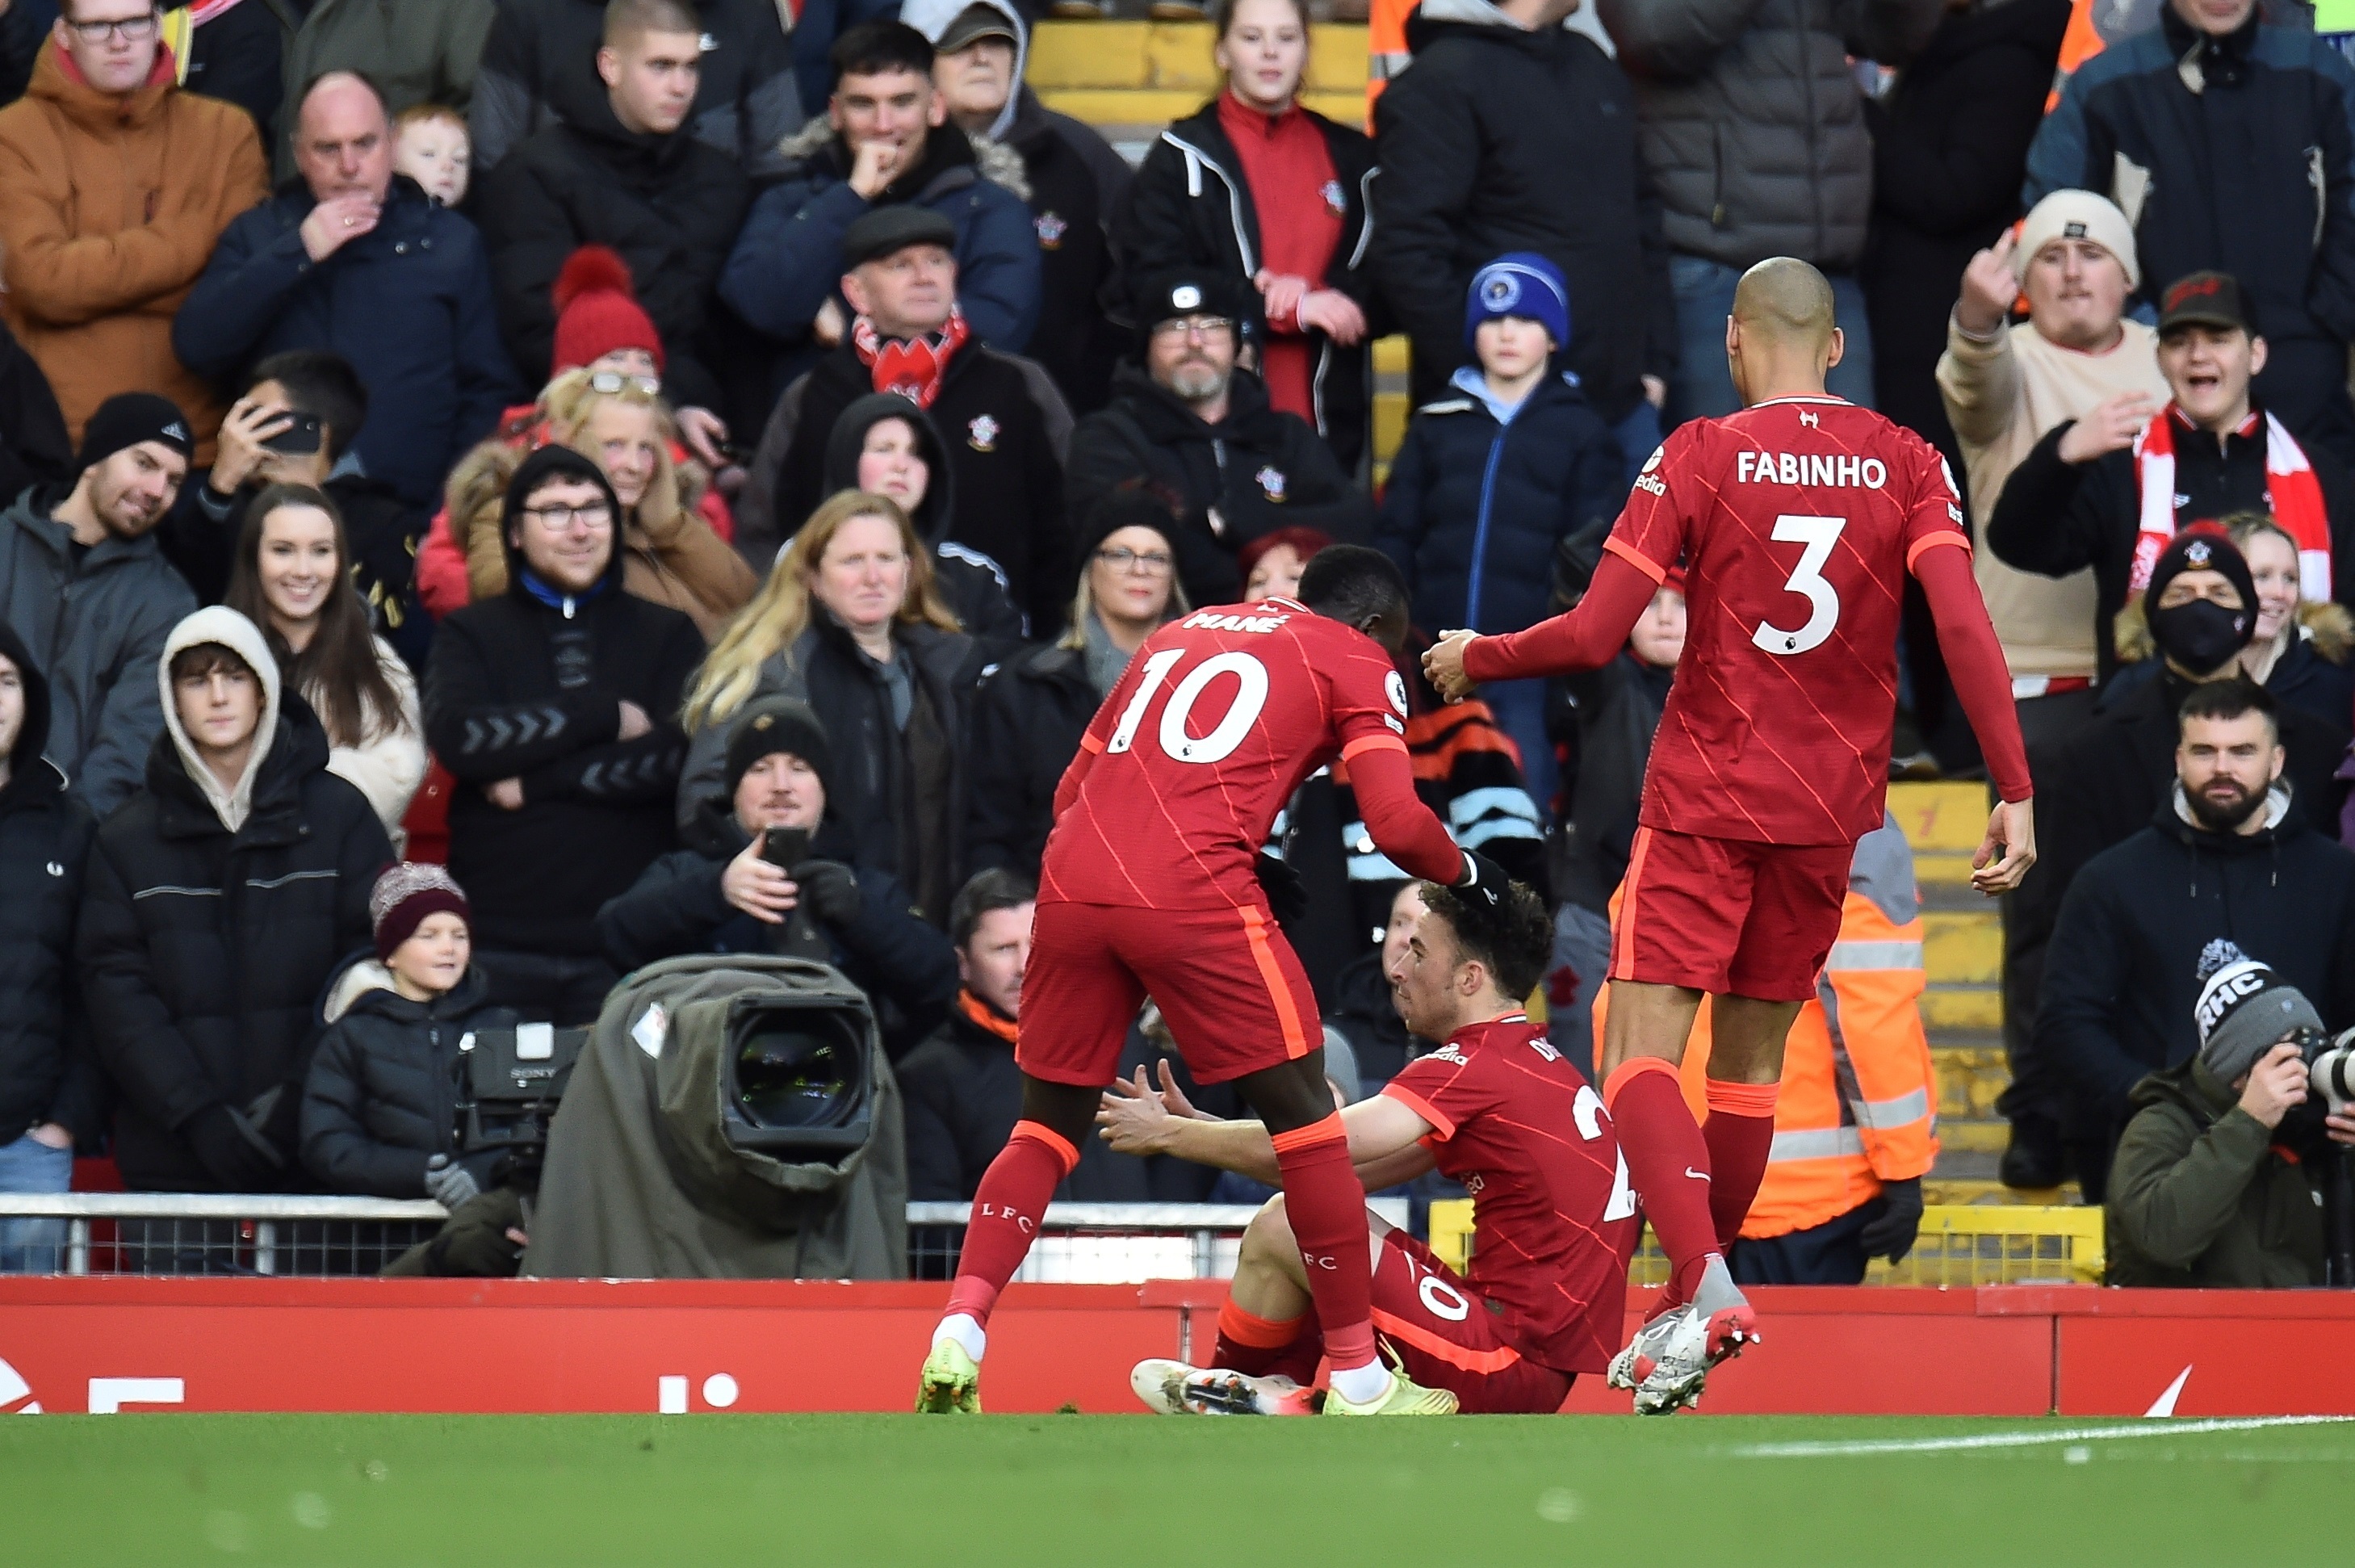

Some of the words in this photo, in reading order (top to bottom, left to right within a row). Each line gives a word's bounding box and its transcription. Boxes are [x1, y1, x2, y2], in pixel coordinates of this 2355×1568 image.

[1737, 451, 1887, 489] FABINHO
[1751, 514, 1847, 655] 3
[1182, 613, 1291, 634] MANÉ
[1107, 648, 1270, 764] 10
[510, 1067, 558, 1079] SONY
